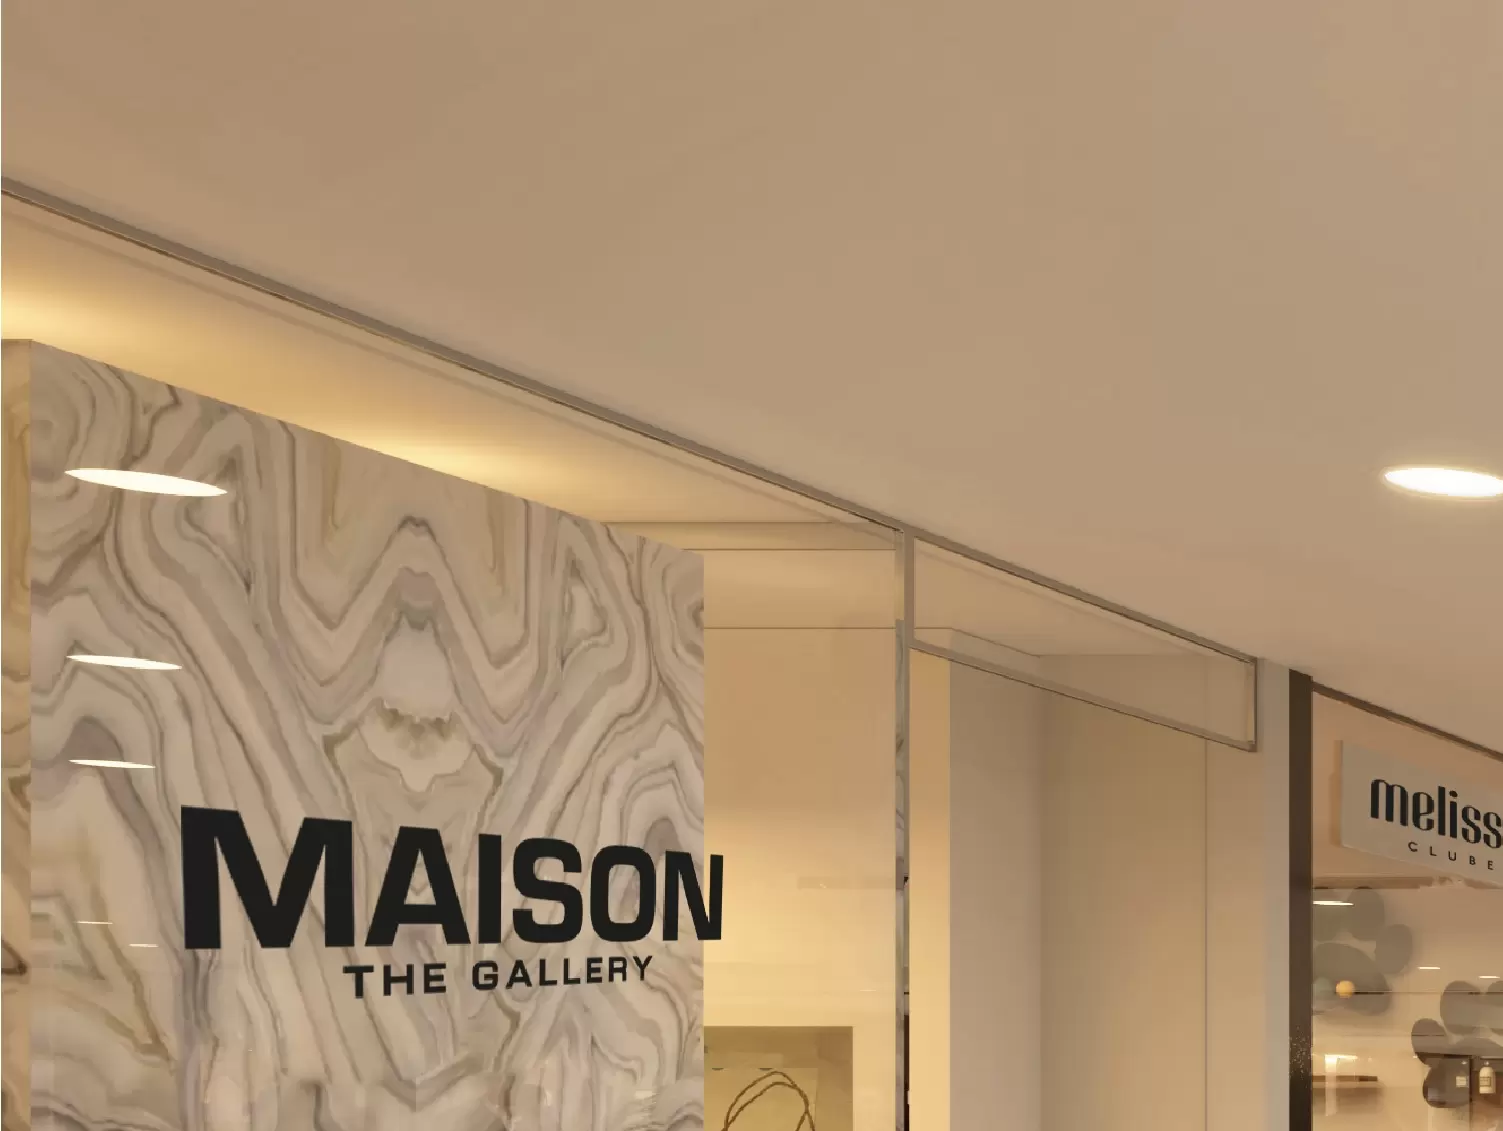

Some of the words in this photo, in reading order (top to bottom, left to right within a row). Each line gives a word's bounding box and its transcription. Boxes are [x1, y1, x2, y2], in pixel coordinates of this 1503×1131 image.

[180, 804, 724, 950] MAISON
[1407, 841, 1494, 870] CLUBE
[342, 962, 447, 999] THE
[471, 955, 653, 992] GALLERY
